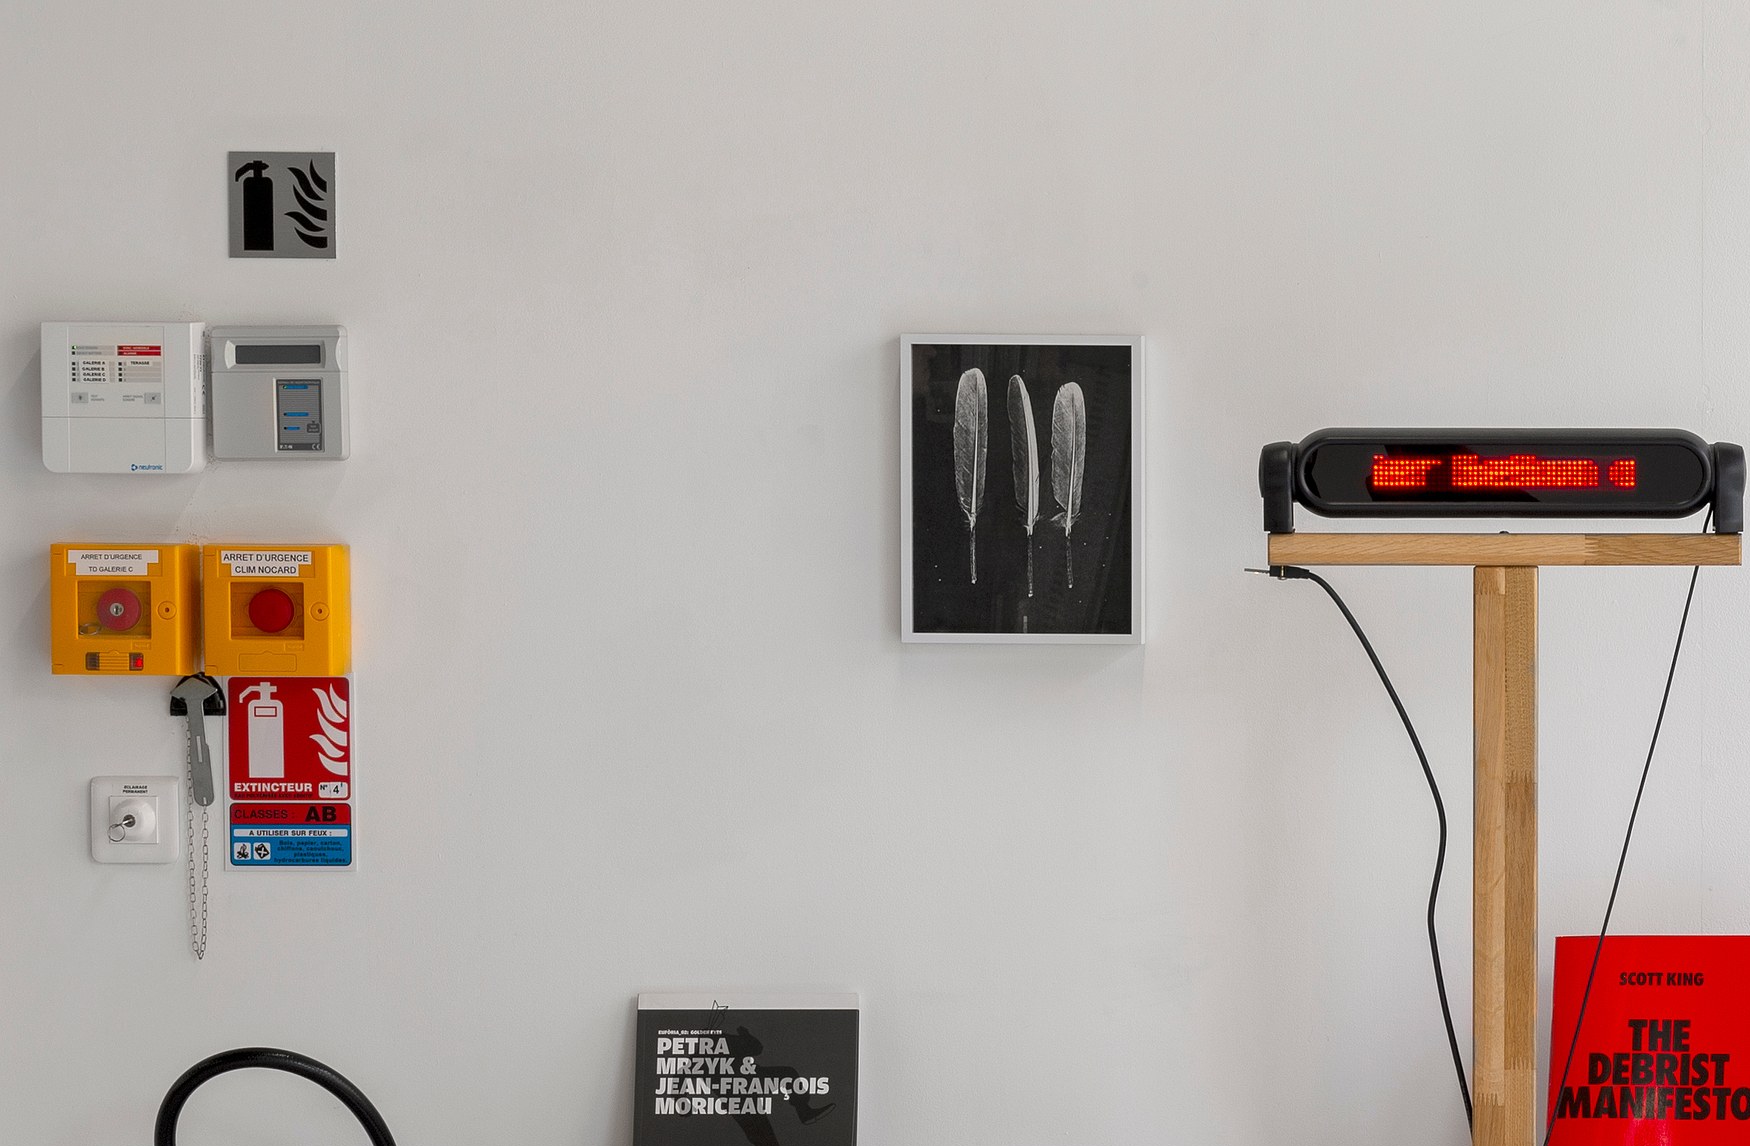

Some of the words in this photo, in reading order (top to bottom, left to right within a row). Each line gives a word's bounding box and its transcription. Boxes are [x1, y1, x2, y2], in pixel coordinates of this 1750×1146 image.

[223, 554, 254, 562] ARRET
[256, 554, 308, 562] D'URGENCE
[235, 566, 256, 574] CLIM
[258, 566, 297, 574] NOCARD
[234, 783, 313, 792] EXTINCTEUR
[333, 786, 340, 794] 4
[234, 810, 288, 818] CLASSES
[305, 806, 336, 822] AB
[1619, 972, 1663, 986] SCOTT
[1666, 972, 1704, 986] KING
[1628, 1019, 1691, 1052] THE
[657, 1038, 730, 1055] PETRA
[656, 1058, 735, 1075] MRZYK
[740, 1056, 757, 1075] &
[1588, 1052, 1730, 1086] DEBRIST
[655, 1077, 830, 1100] JEAN-FRANÇOIS
[655, 1097, 772, 1115] MORICEAU
